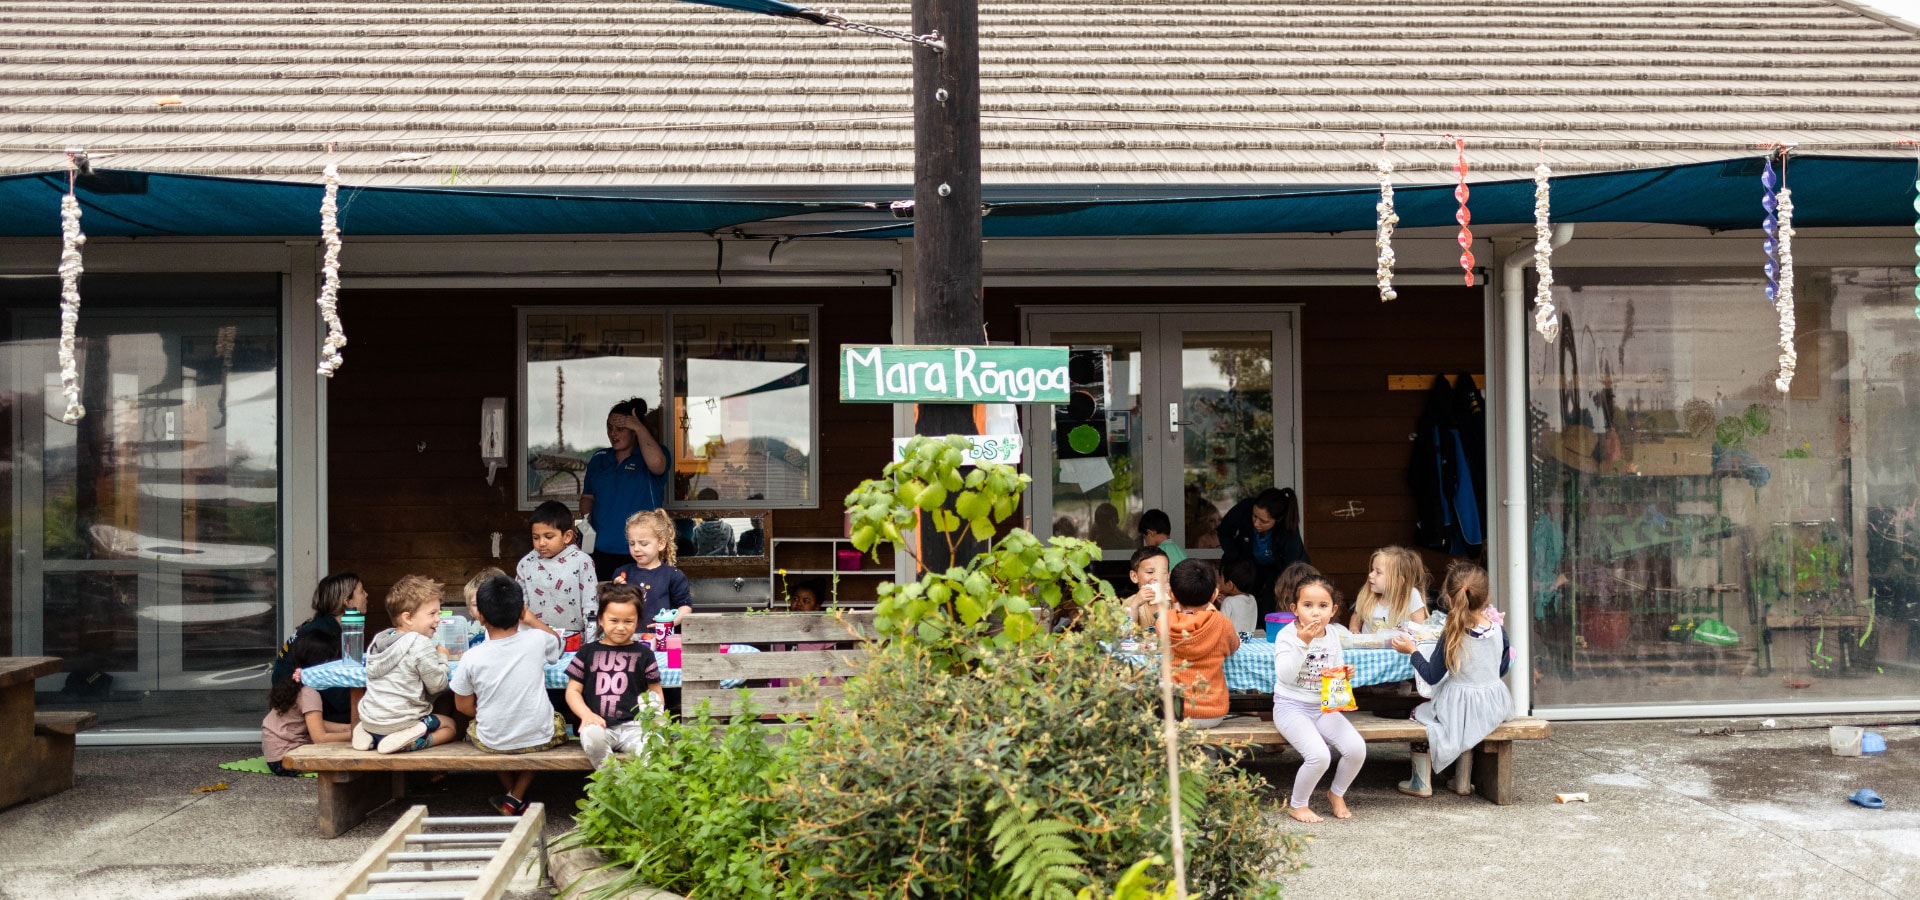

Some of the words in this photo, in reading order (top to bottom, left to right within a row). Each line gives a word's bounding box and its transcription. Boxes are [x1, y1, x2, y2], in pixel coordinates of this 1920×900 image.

[846, 346, 948, 399] Mara
[953, 347, 1070, 402] Rōngoa
[590, 650, 642, 673] JUST
[595, 671, 629, 696] DO
[600, 694, 623, 718] IT.
